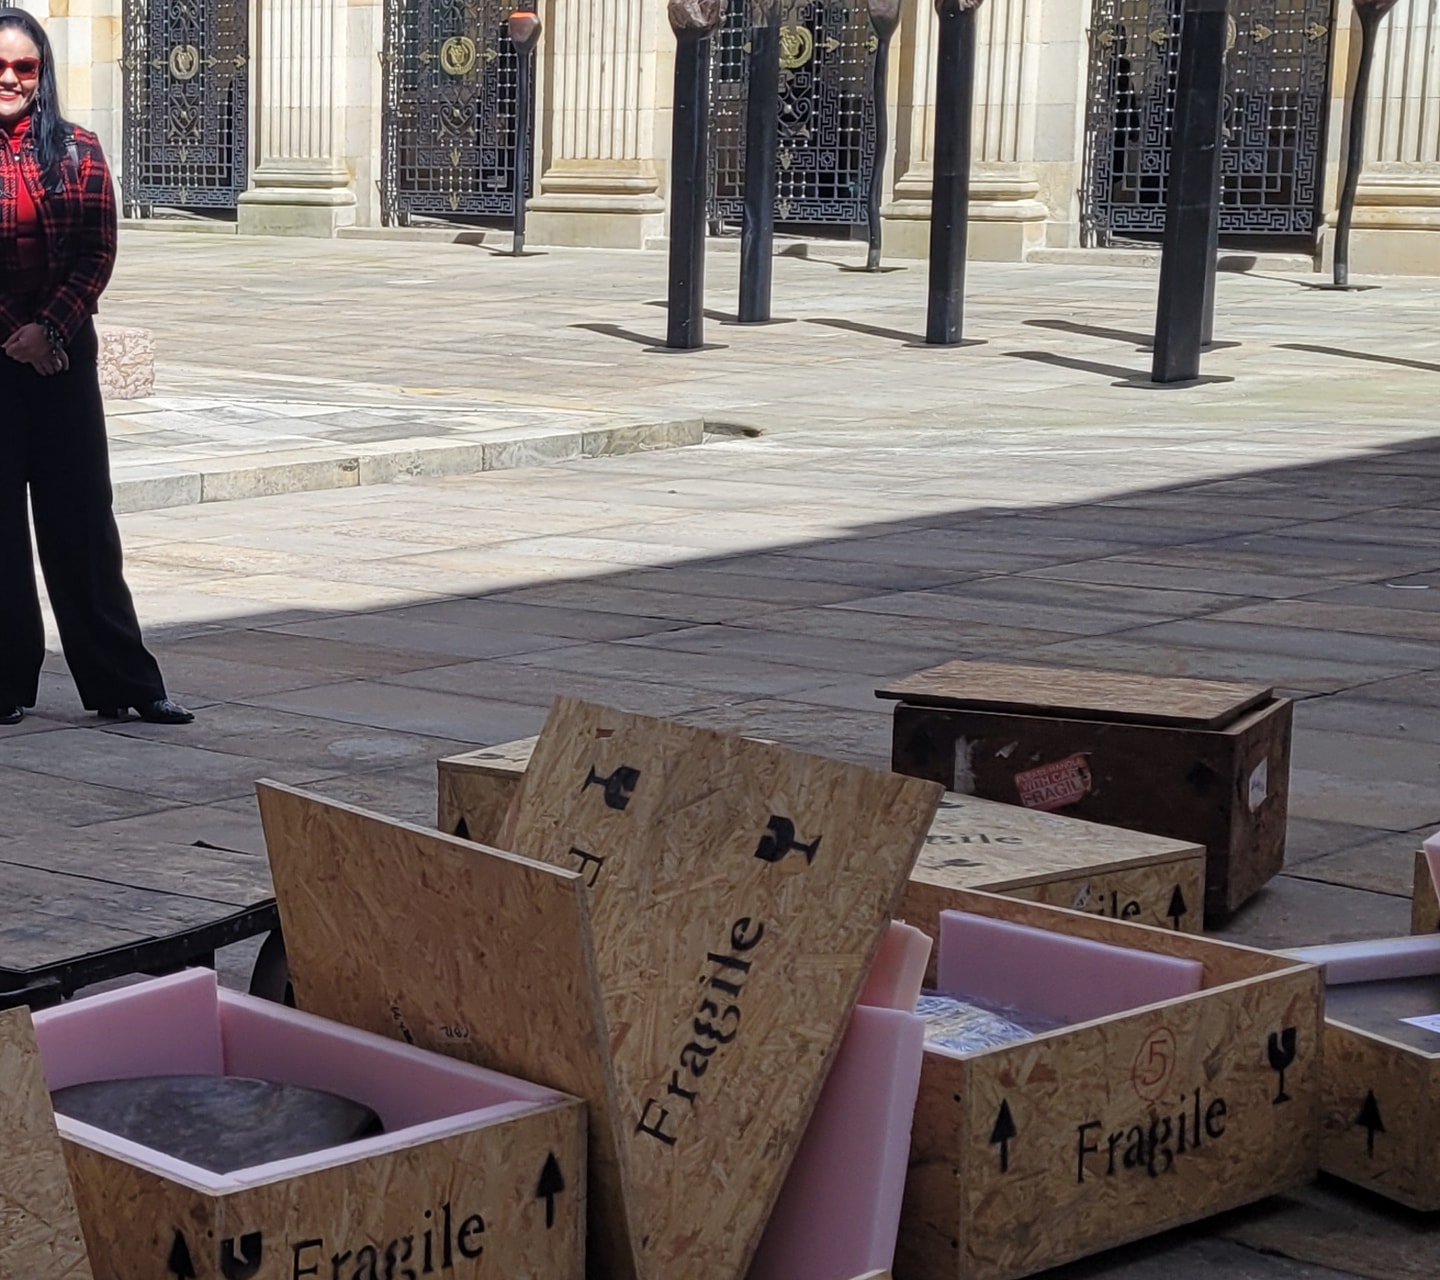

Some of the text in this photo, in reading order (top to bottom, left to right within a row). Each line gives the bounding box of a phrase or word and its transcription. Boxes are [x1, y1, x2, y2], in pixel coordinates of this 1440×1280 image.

[1022, 767, 1082, 792] WITH CAR
[1022, 778, 1081, 806] FRAGIL
[635, 917, 764, 1147] Fragile
[1077, 1086, 1228, 1184] Fragile
